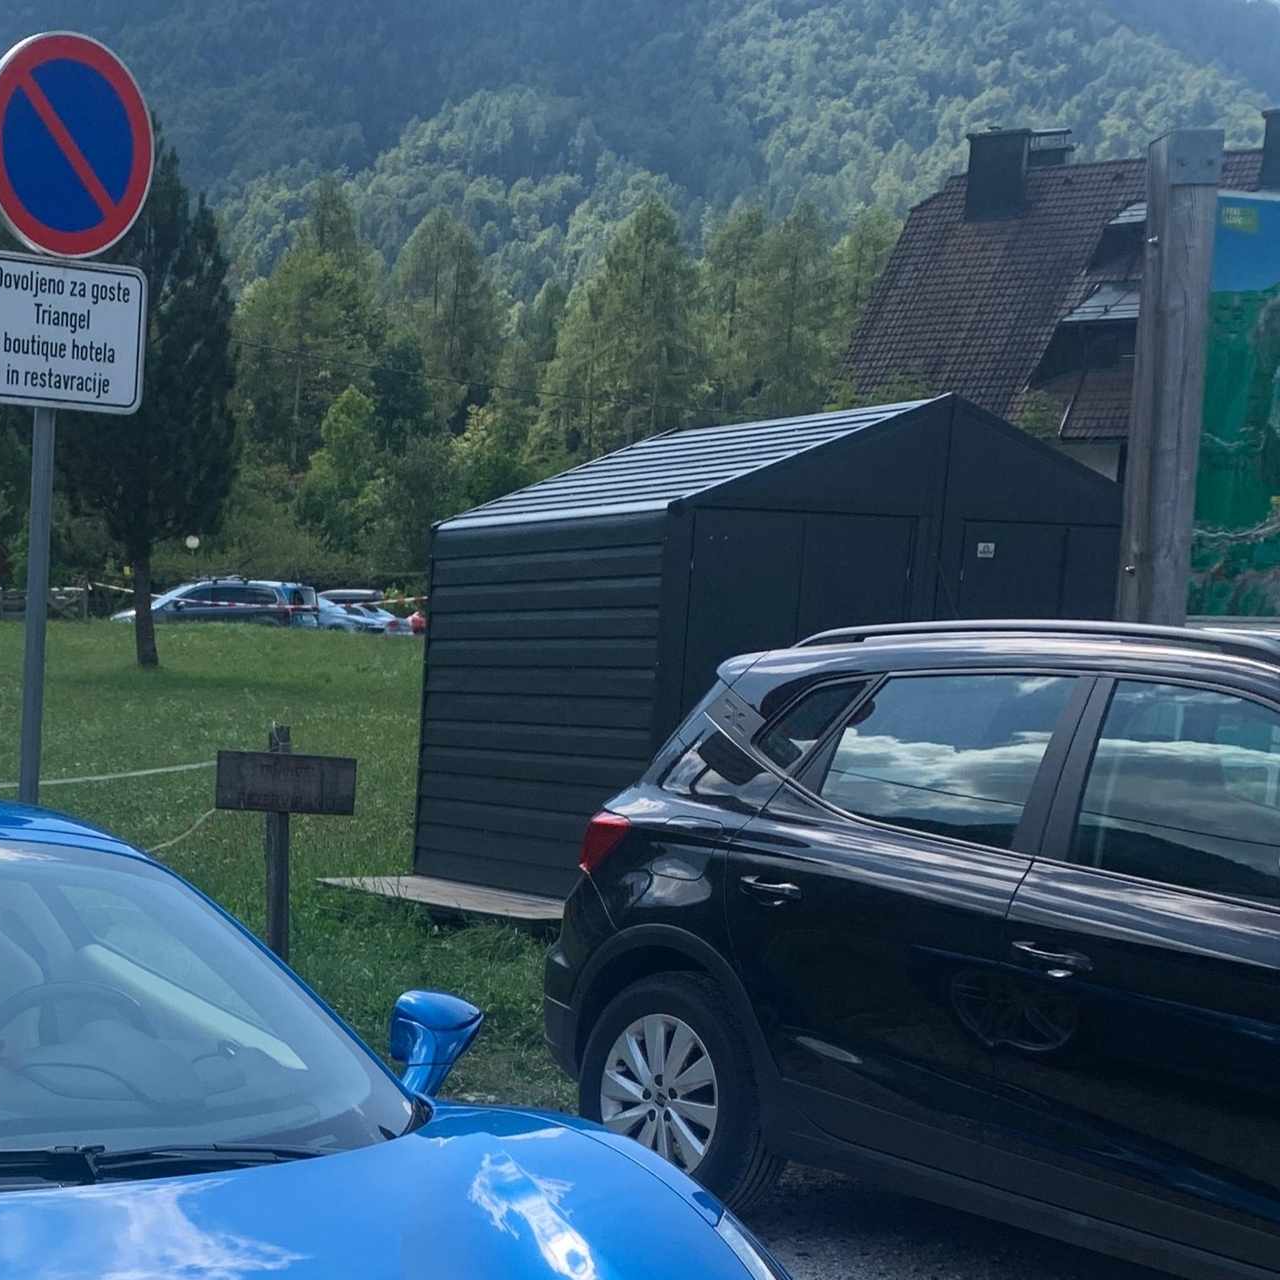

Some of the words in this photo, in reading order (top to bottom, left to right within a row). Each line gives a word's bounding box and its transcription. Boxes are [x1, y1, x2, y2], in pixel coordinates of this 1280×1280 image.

[69, 281, 86, 298] za
[91, 281, 131, 304] goste
[34, 303, 91, 333] Triangel
[3, 332, 67, 362] boutique
[71, 339, 115, 363] hotela
[6, 364, 19, 385] in
[23, 367, 110, 399] restavracije
